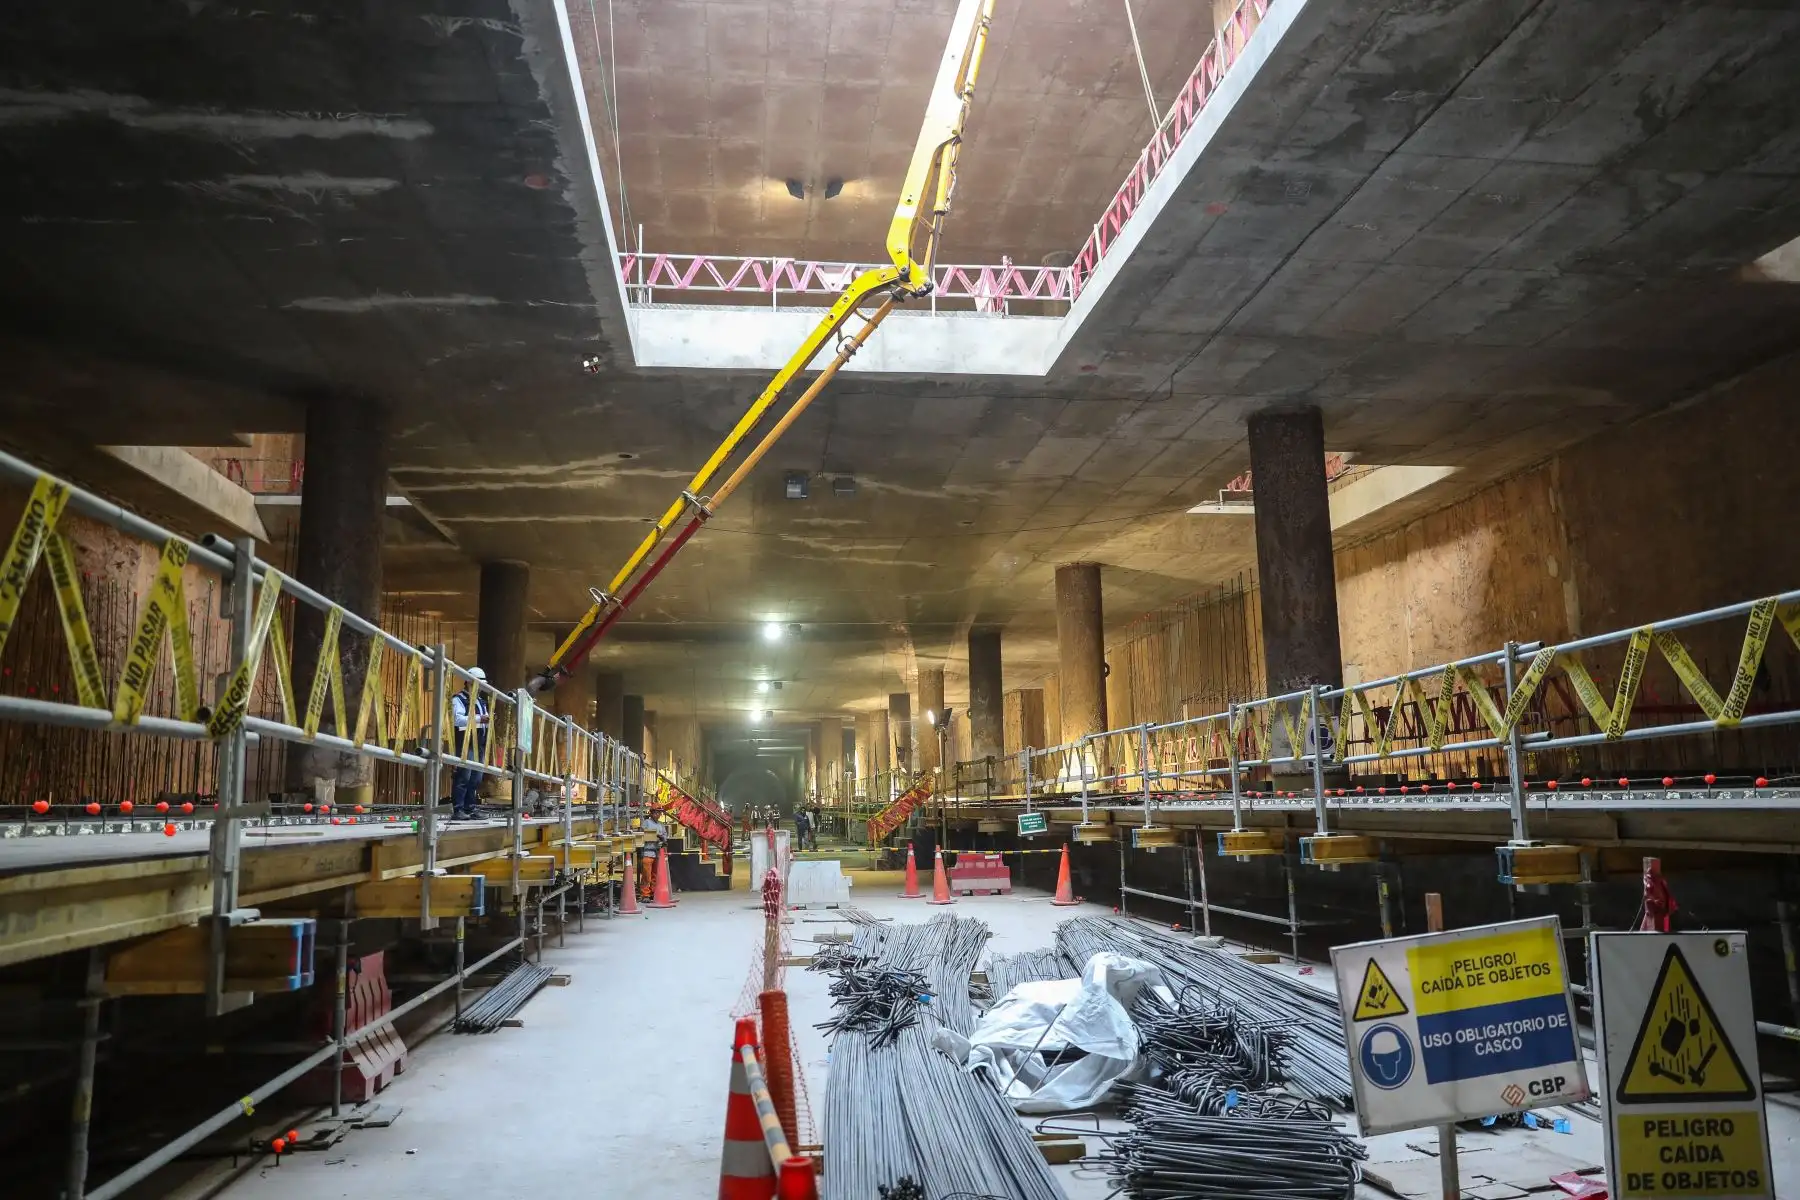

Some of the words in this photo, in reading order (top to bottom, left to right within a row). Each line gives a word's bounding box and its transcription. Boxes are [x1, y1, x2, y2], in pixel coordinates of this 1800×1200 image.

[1748, 623, 1761, 639] NO
[124, 665, 143, 692] NO
[136, 600, 164, 658] PASAR
[1507, 688, 1525, 716] PASAR
[1724, 666, 1746, 719] PELIGRO
[1733, 674, 1753, 719] OBRAS
[1451, 952, 1517, 977] ¡PELIGRO!
[1421, 975, 1464, 994] CAÍDA
[1467, 973, 1485, 987] DE
[1490, 962, 1551, 985] OBJETOS
[1422, 1033, 1452, 1049] USO
[1456, 1016, 1546, 1044] OBLIGATORIO
[1548, 1013, 1568, 1028] DE
[1474, 1037, 1522, 1056] CASCO
[1528, 1076, 1566, 1096] CBP
[1644, 1118, 1735, 1138] PELIGRO
[1659, 1141, 1724, 1164] CAÍDA
[1627, 1172, 1655, 1191] DE
[1662, 1170, 1760, 1190] OBJETOS
